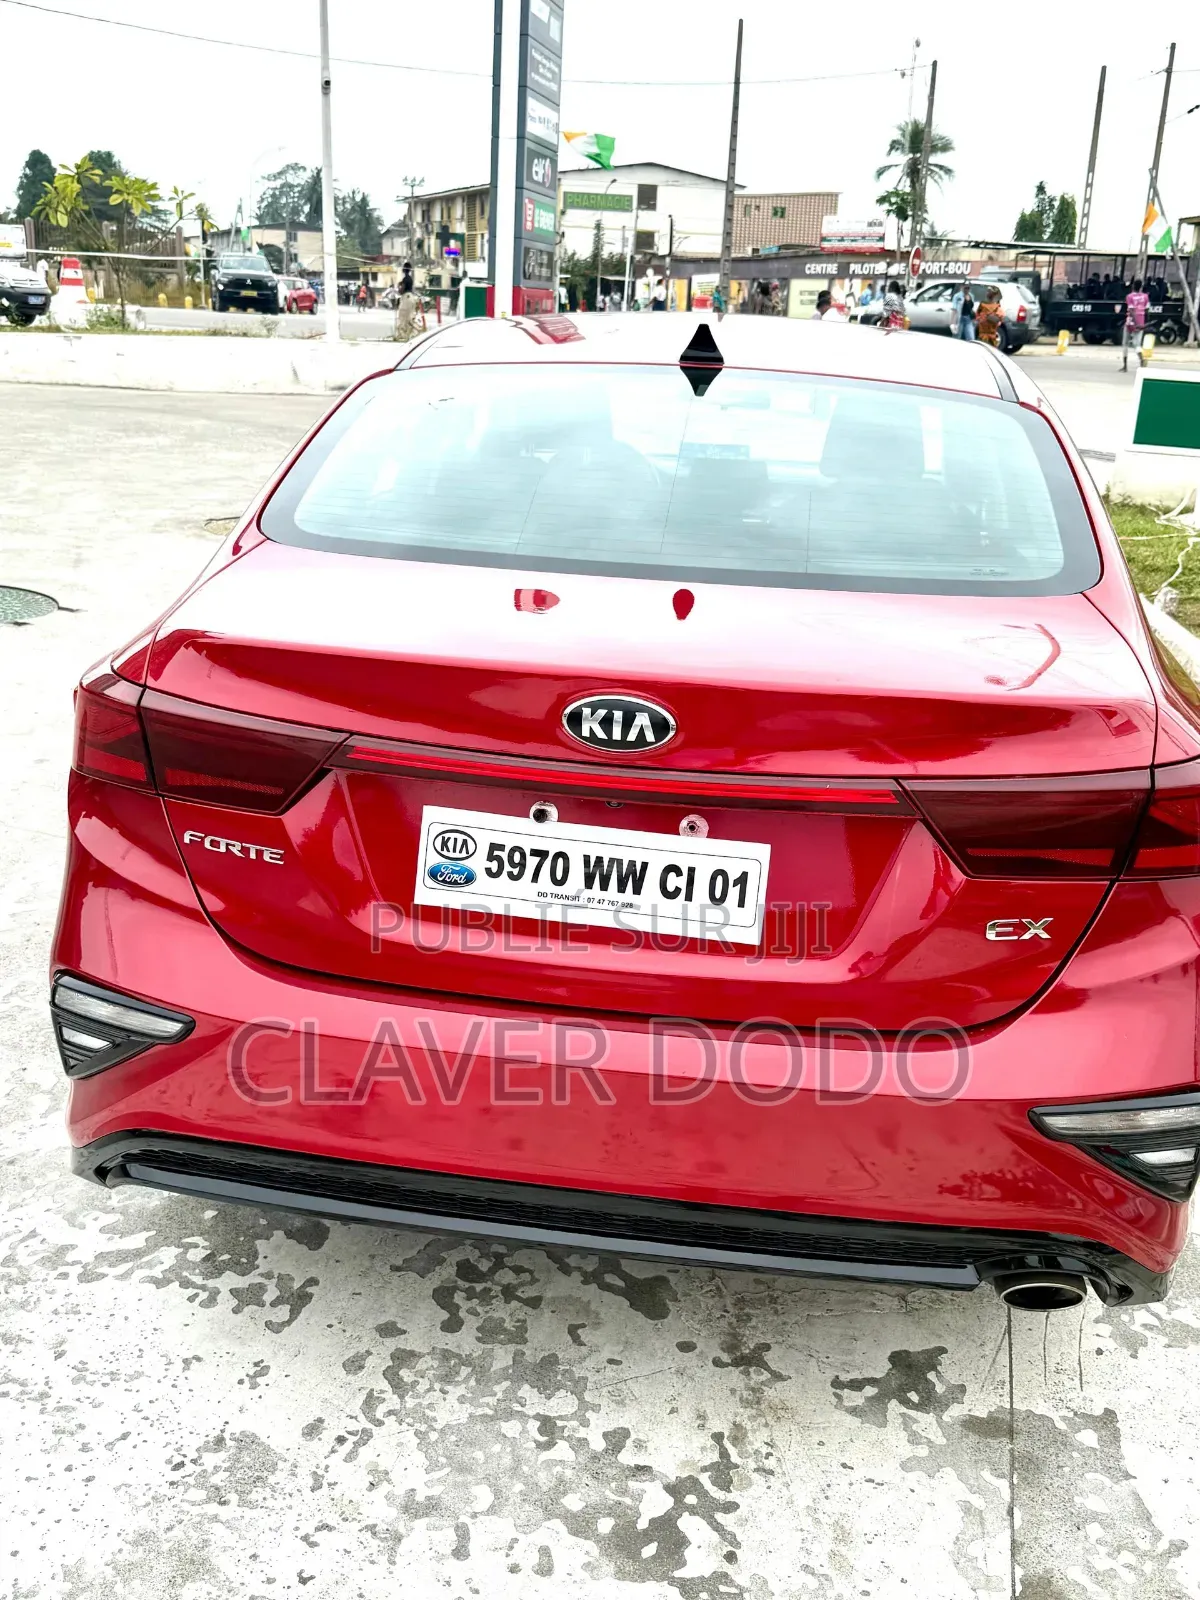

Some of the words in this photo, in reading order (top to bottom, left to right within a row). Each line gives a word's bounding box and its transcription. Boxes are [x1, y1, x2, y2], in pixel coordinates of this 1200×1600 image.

[567, 193, 632, 209] PHARMACIE
[805, 263, 838, 275] CENTRE
[919, 262, 971, 275] PORT-BOU
[581, 707, 656, 742] KIA
[183, 830, 285, 865] FORTE
[440, 836, 470, 855] KIA
[437, 864, 467, 884] Ford
[484, 842, 570, 887] 5970
[583, 854, 649, 895] WW
[659, 864, 696, 902] CI
[708, 869, 748, 908] 01
[550, 892, 581, 902] TRANSIT
[986, 917, 1054, 940] EX
